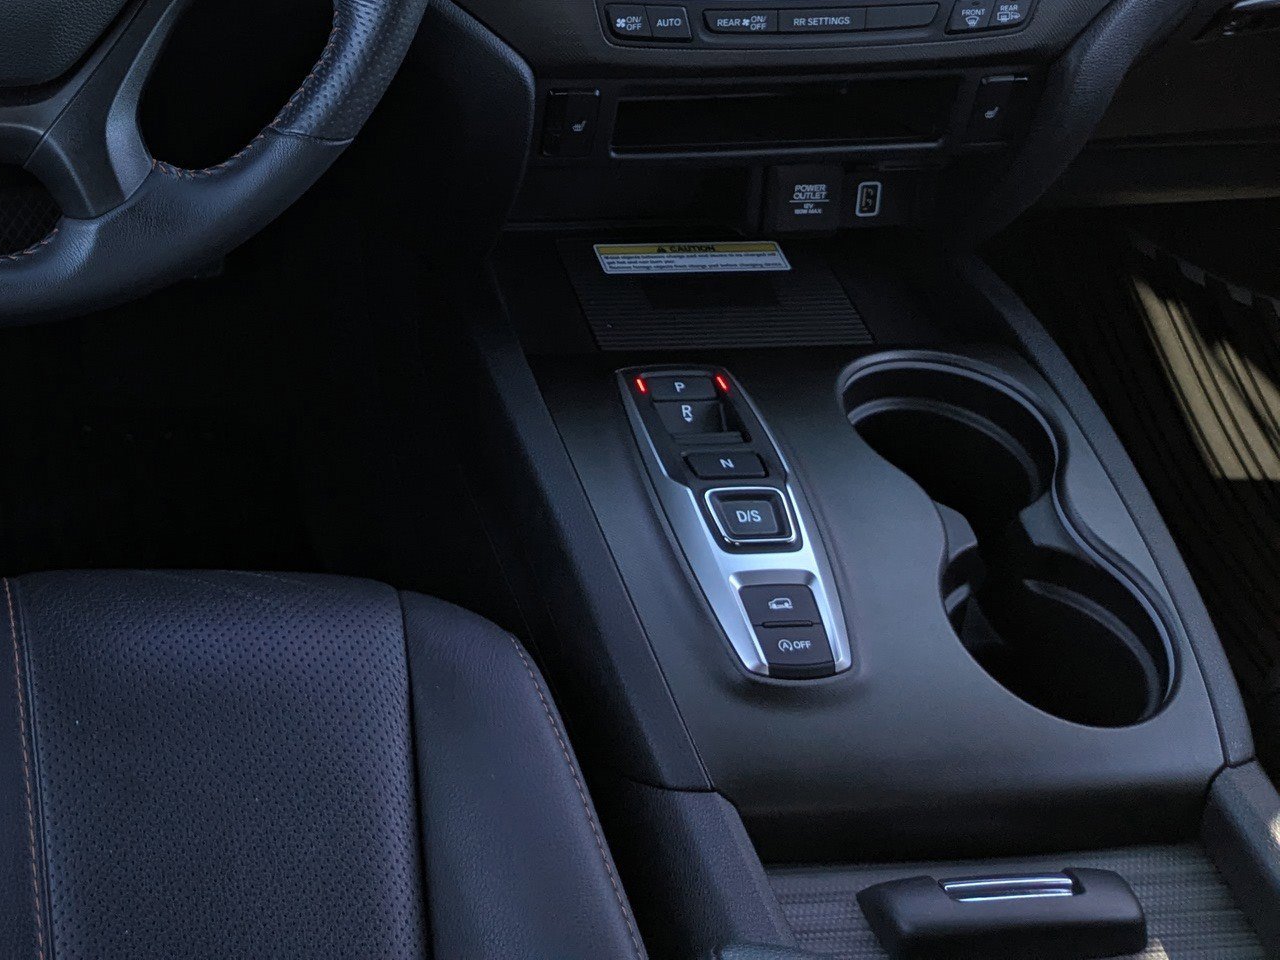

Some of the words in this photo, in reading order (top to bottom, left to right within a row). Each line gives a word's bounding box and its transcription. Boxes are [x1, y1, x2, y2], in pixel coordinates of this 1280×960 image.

[961, 8, 986, 17] FRONT
[1000, 4, 1018, 12] REAR
[626, 16, 642, 24] ON/
[656, 18, 681, 27] AUTO
[717, 19, 740, 27] REAR
[793, 17, 806, 26] RR
[807, 16, 851, 26] SETTINGS
[750, 23, 767, 31] OFF
[794, 184, 826, 192] POWER
[793, 192, 827, 200] OUTLET
[670, 245, 715, 253] CAUTION
[674, 382, 686, 392] P
[681, 404, 692, 418] R
[720, 458, 735, 468] N
[736, 510, 762, 523] D/S
[793, 640, 811, 649] OFF
